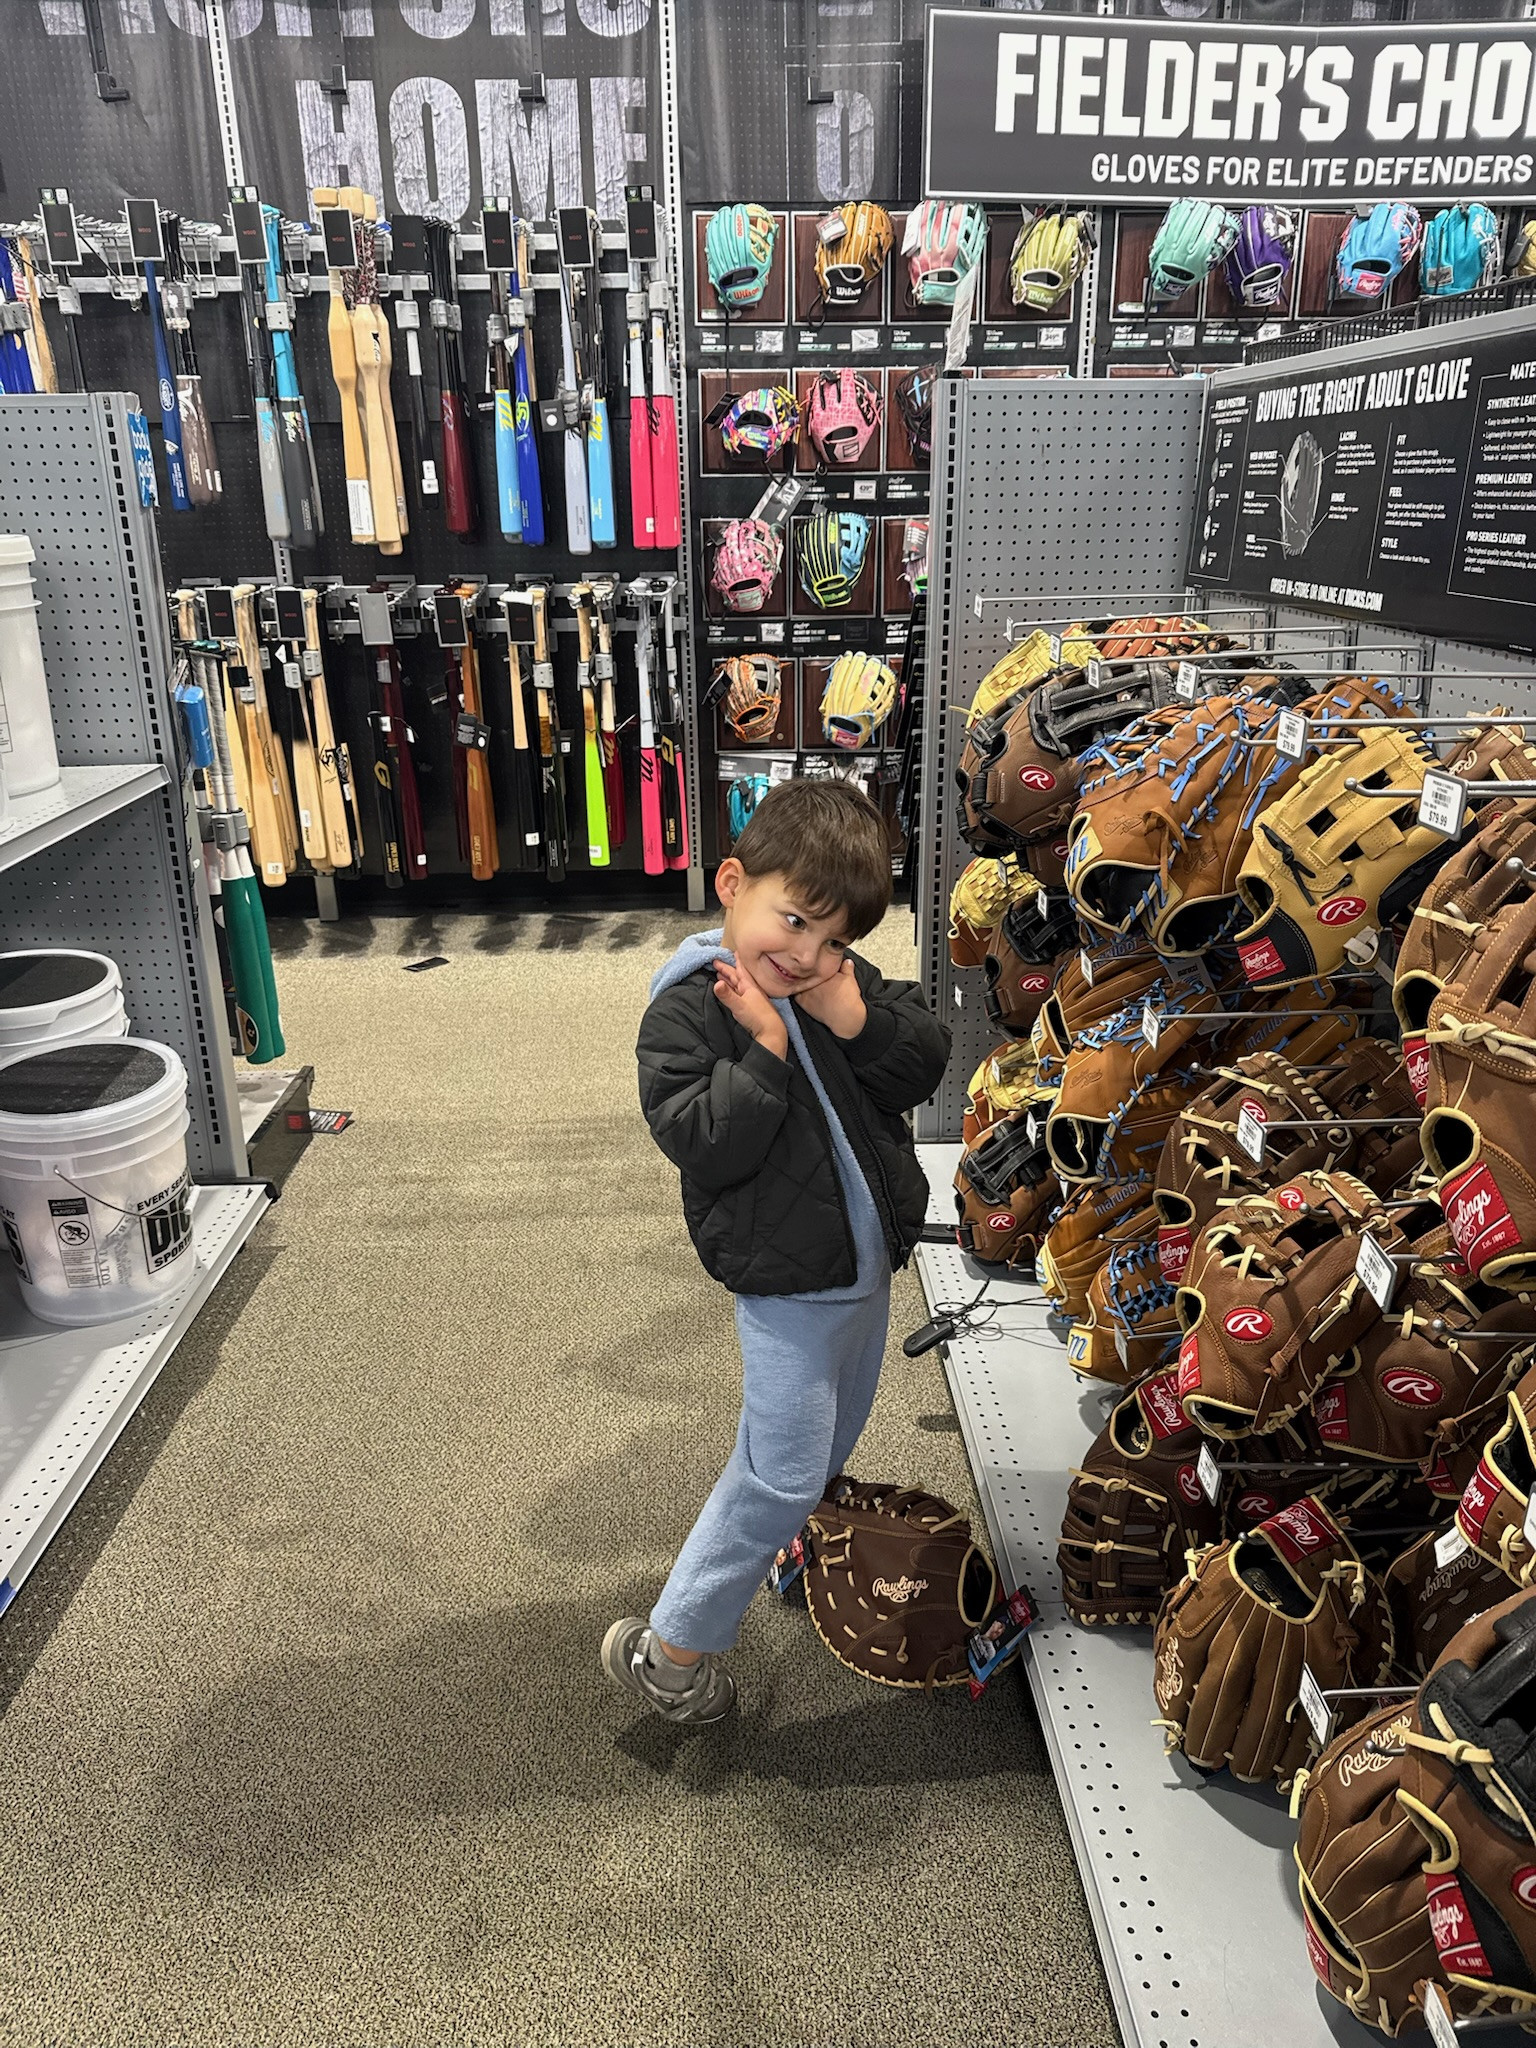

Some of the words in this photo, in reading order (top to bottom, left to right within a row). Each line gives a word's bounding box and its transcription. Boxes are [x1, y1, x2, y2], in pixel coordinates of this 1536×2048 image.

[995, 32, 1354, 142] FIELDER'S
[295, 76, 648, 222] HOME
[1091, 153, 1200, 184] GLOVES
[1206, 157, 1260, 186] FOR
[1265, 157, 1349, 187] ELITE
[1354, 154, 1533, 187] DEFENDERS
[733, 286, 760, 300] Wilson
[836, 286, 862, 297] Wilson
[1256, 386, 1298, 423] BUYING
[1299, 382, 1324, 418] THE
[1323, 376, 1366, 415] RIGHT
[1367, 367, 1416, 410] ADULT
[1417, 357, 1473, 403] GLOVE
[1487, 396, 1520, 410] SYNTHETIC
[1396, 434, 1407, 446] FIT
[1475, 473, 1504, 485] PREMIUM
[1504, 473, 1533, 485] LEATHER
[1389, 486, 1403, 497] FEEL
[1381, 537, 1399, 549] STYLE
[1466, 531, 1478, 542] PRO
[1478, 531, 1498, 543] SERIES
[1498, 532, 1527, 545] LEATHER
[1270, 577, 1287, 594] ORDER
[1287, 580, 1310, 599] IN-STORE
[1310, 584, 1318, 600] OR
[1318, 585, 1338, 604] ONLINE
[1344, 588, 1383, 612] DICKS.COM
[1428, 811, 1448, 827] $79.99
[1321, 900, 1359, 921] R
[137, 1189, 170, 1211] EVERY
[1094, 1182, 1140, 1217] marucci
[1363, 1269, 1378, 1294] $79.99
[1226, 1312, 1264, 1335] R
[1387, 1376, 1435, 1402] R
[1151, 1384, 1182, 1427] Rawlings
[873, 1576, 929, 1602] Rawlings
